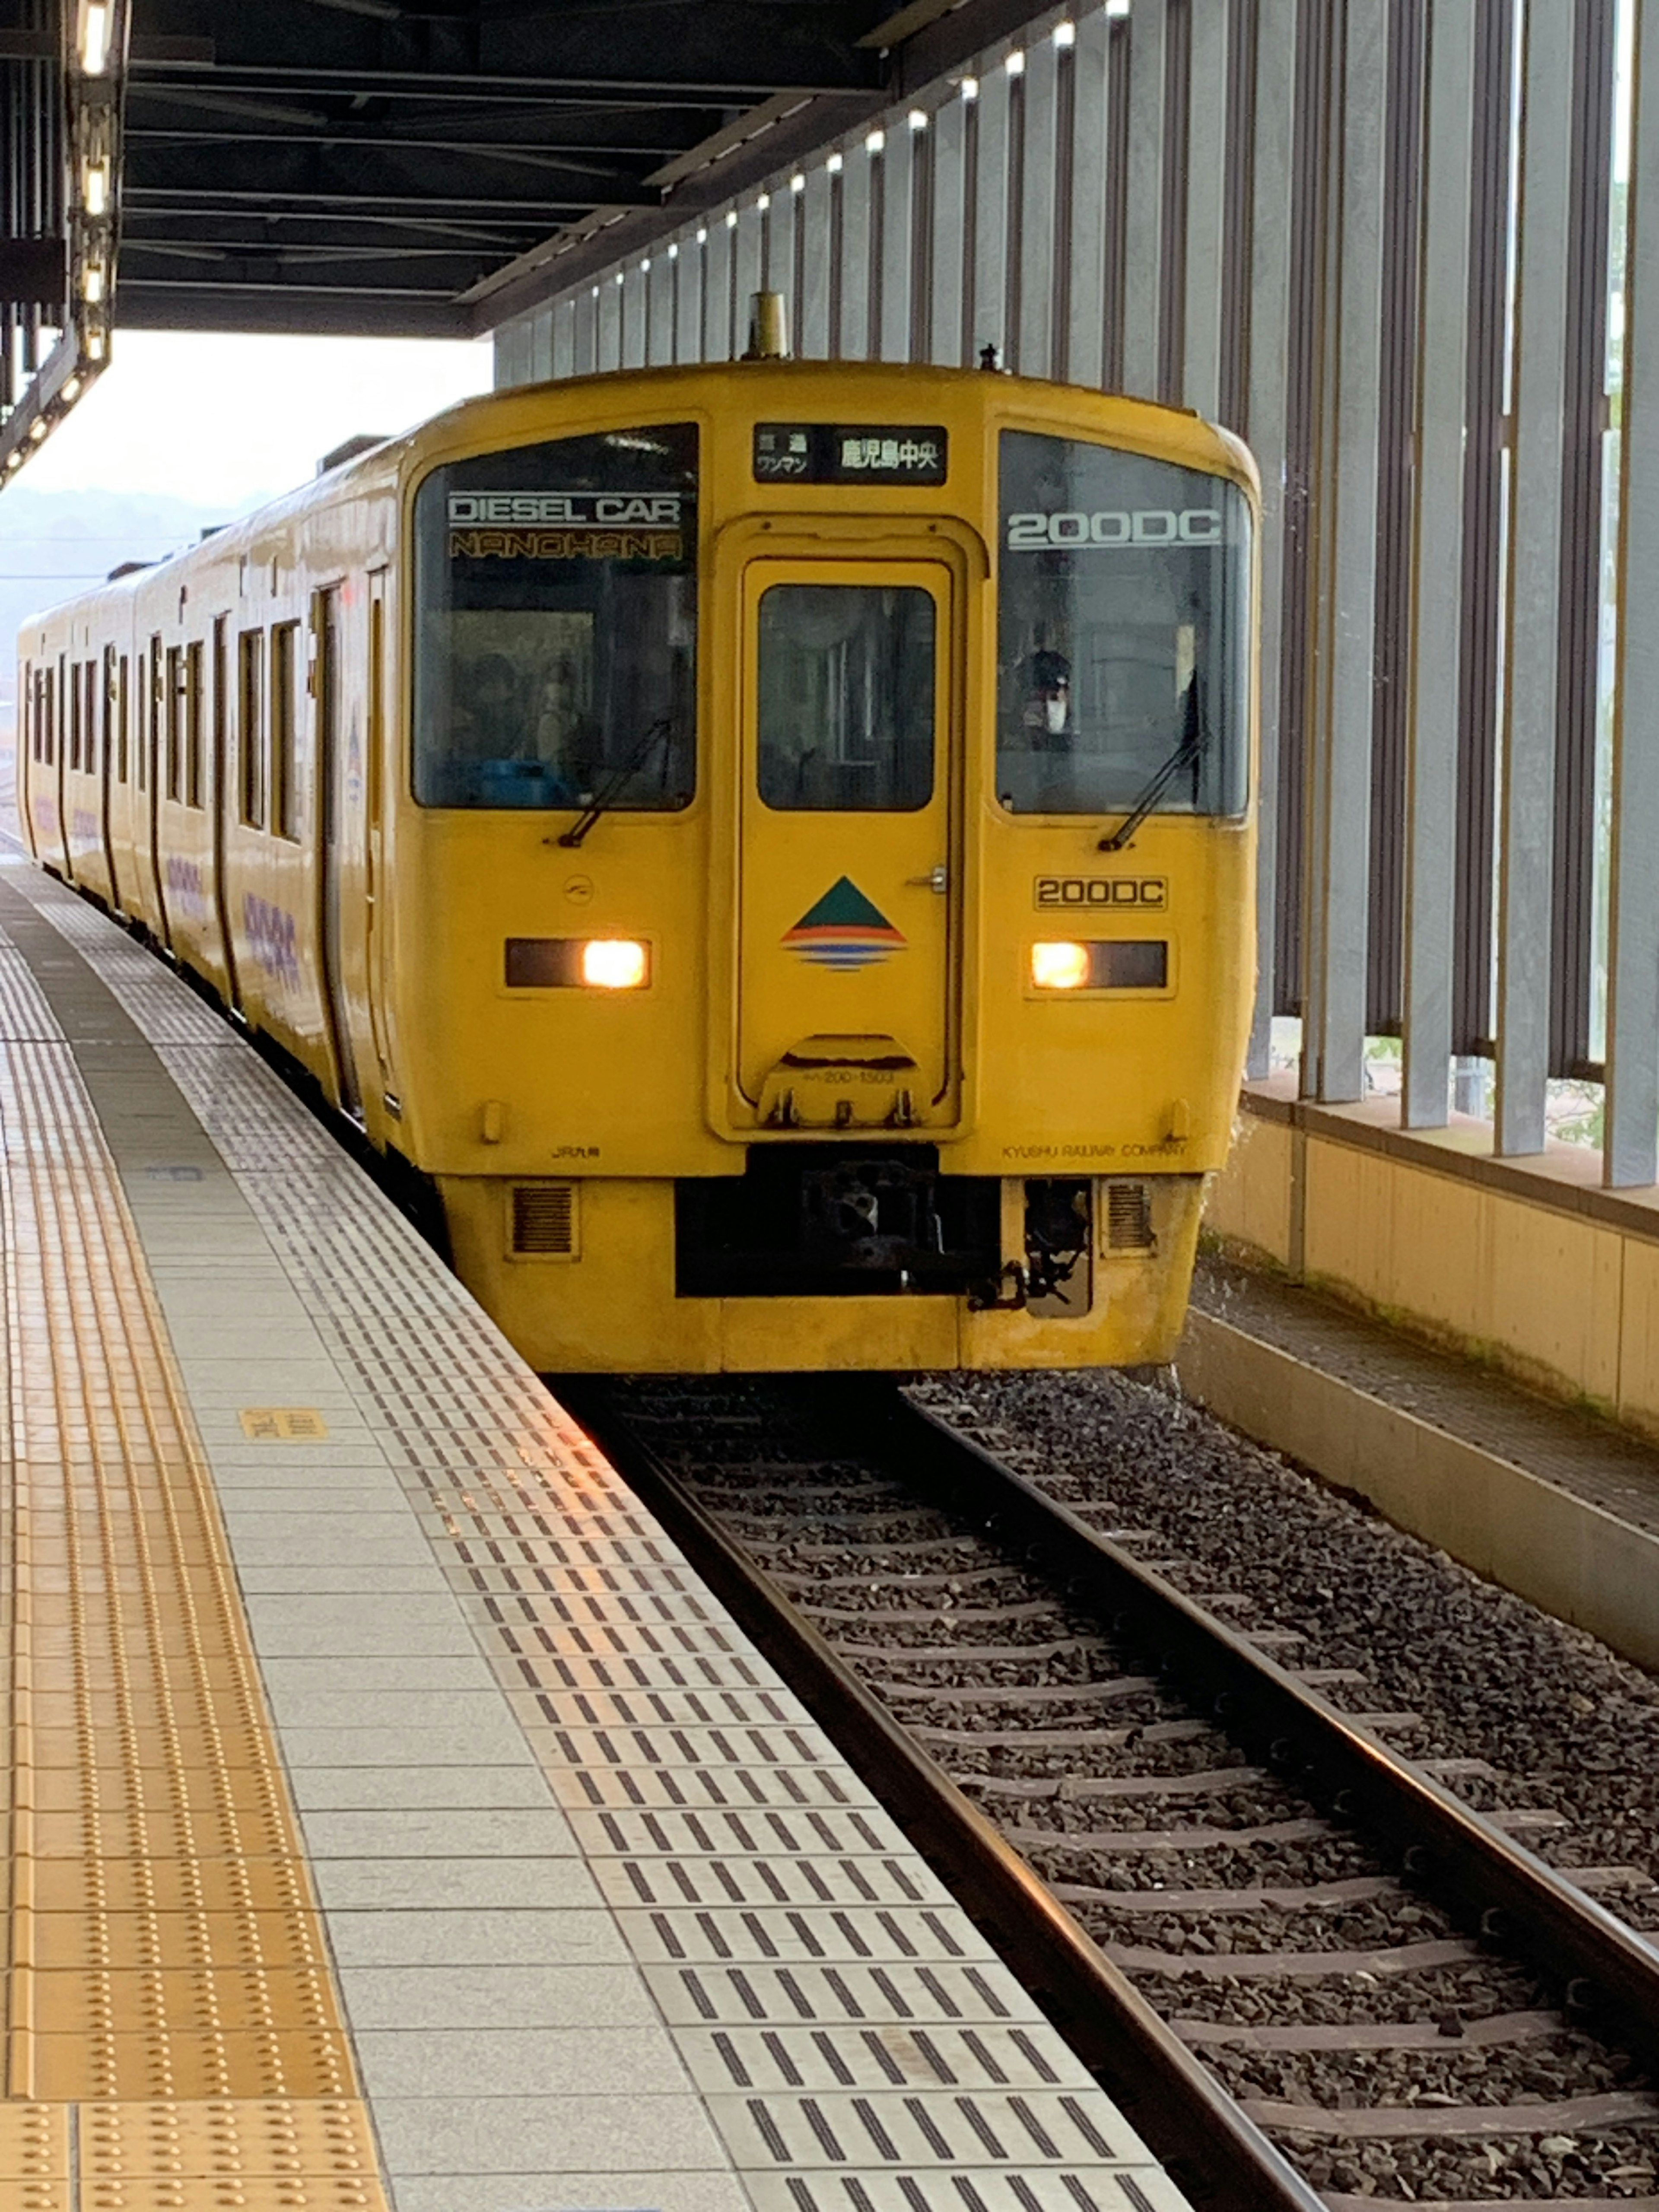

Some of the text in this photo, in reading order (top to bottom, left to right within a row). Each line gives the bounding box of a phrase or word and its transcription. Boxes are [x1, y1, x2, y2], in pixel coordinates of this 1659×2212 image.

[842, 439, 938, 469] 鹿児島中央
[448, 498, 680, 522] DIESEL CAR
[1007, 510, 1221, 545] 200DC
[450, 532, 682, 560] NANOHANA
[1039, 880, 1163, 903] 200DC
[1002, 1144, 1186, 1159] KYUSHU RAILWAY COMPANY
